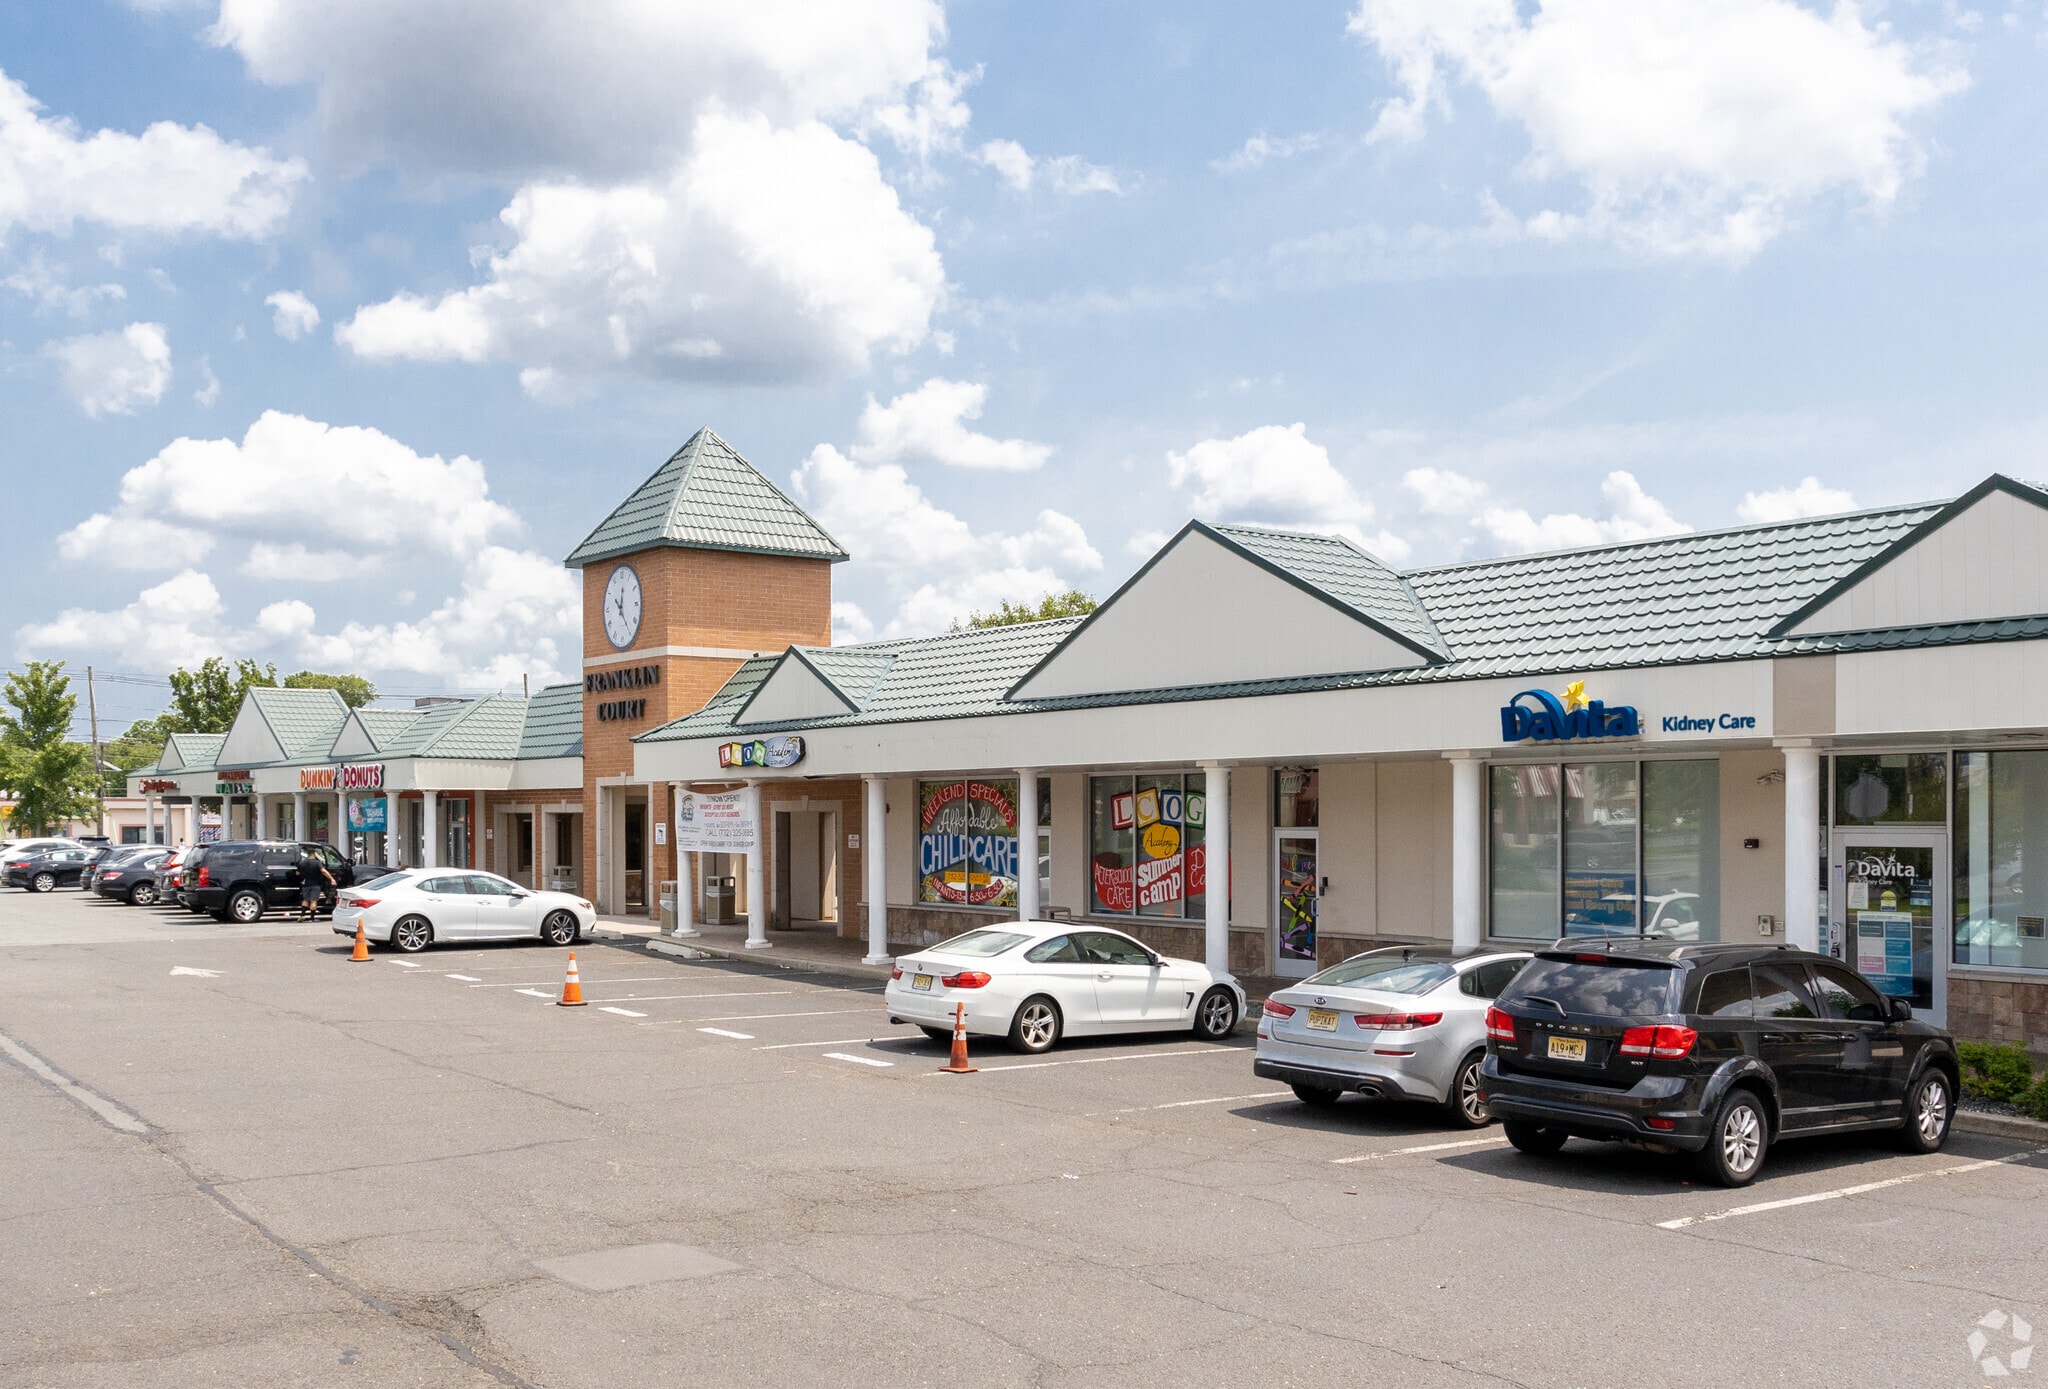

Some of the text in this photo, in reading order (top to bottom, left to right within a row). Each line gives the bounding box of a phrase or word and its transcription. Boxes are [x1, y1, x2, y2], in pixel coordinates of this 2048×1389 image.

[586, 665, 659, 692] FRANKLIN
[597, 698, 646, 721] COURT
[1501, 689, 1639, 742] DaVita
[1662, 713, 1756, 733] Kidney Care
[300, 763, 382, 790] DUNKIN' DONUTS
[923, 783, 1014, 824] WEEKEND SPECIALS
[1115, 795, 1203, 824] LCOG
[1138, 853, 1182, 888] Summer
[1858, 855, 1916, 877] DaVita
[1106, 886, 1133, 908] CARE
[1140, 872, 1181, 906] camp
